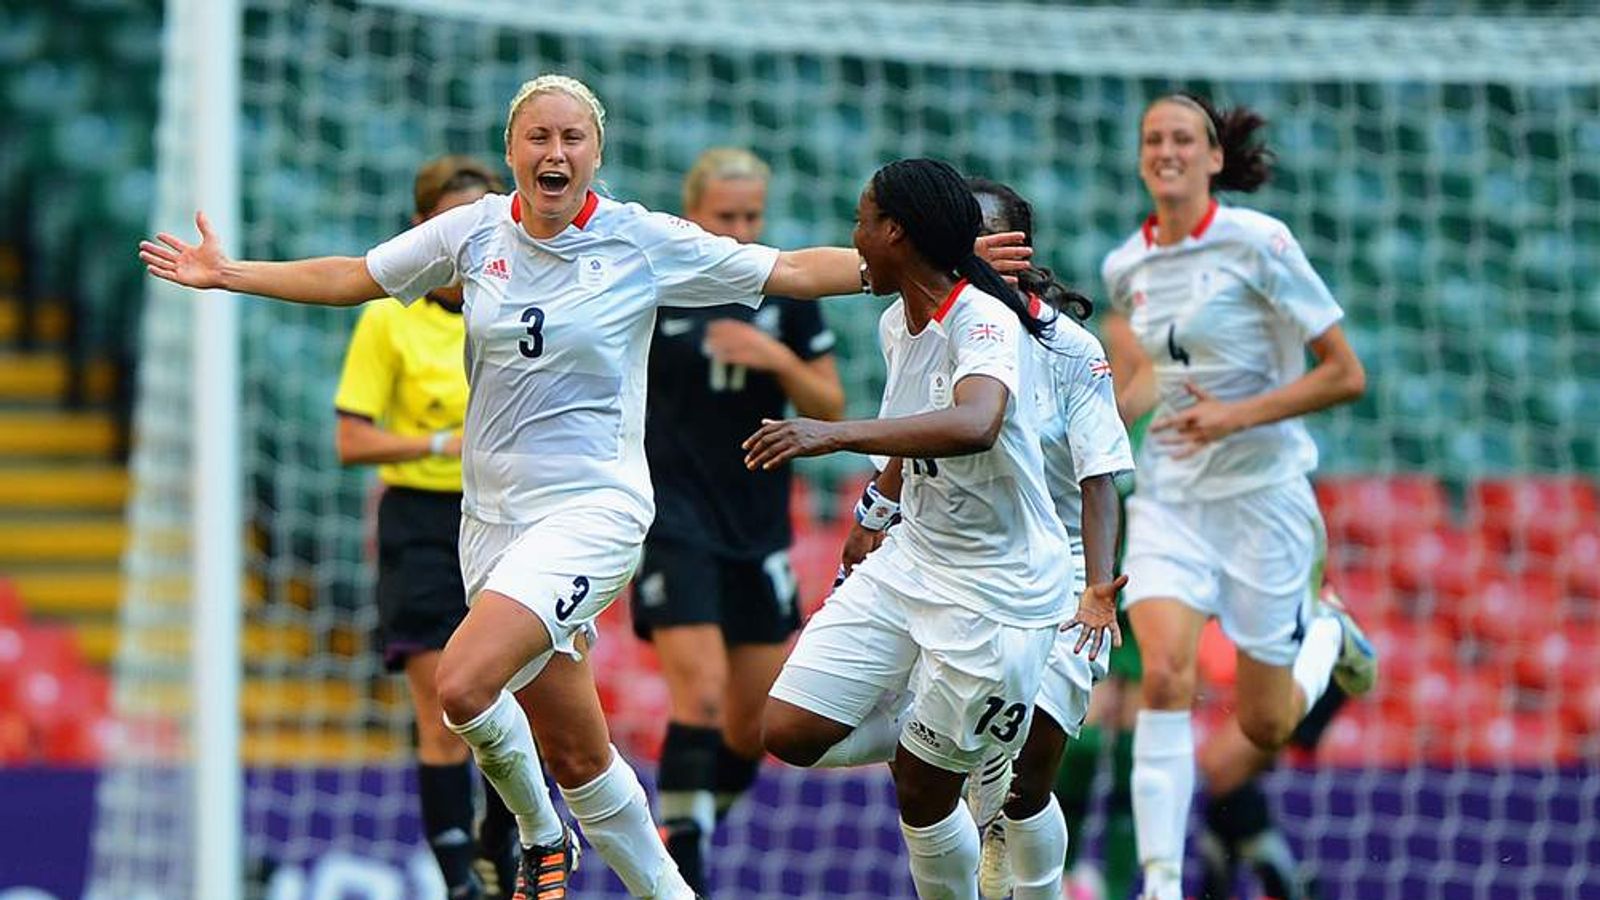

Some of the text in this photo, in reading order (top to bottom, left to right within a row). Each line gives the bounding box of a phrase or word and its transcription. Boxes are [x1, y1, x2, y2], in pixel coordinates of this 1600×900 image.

[519, 307, 545, 358] 3
[1168, 323, 1190, 366] 4
[556, 575, 590, 621] 3
[974, 696, 1027, 743] 13
